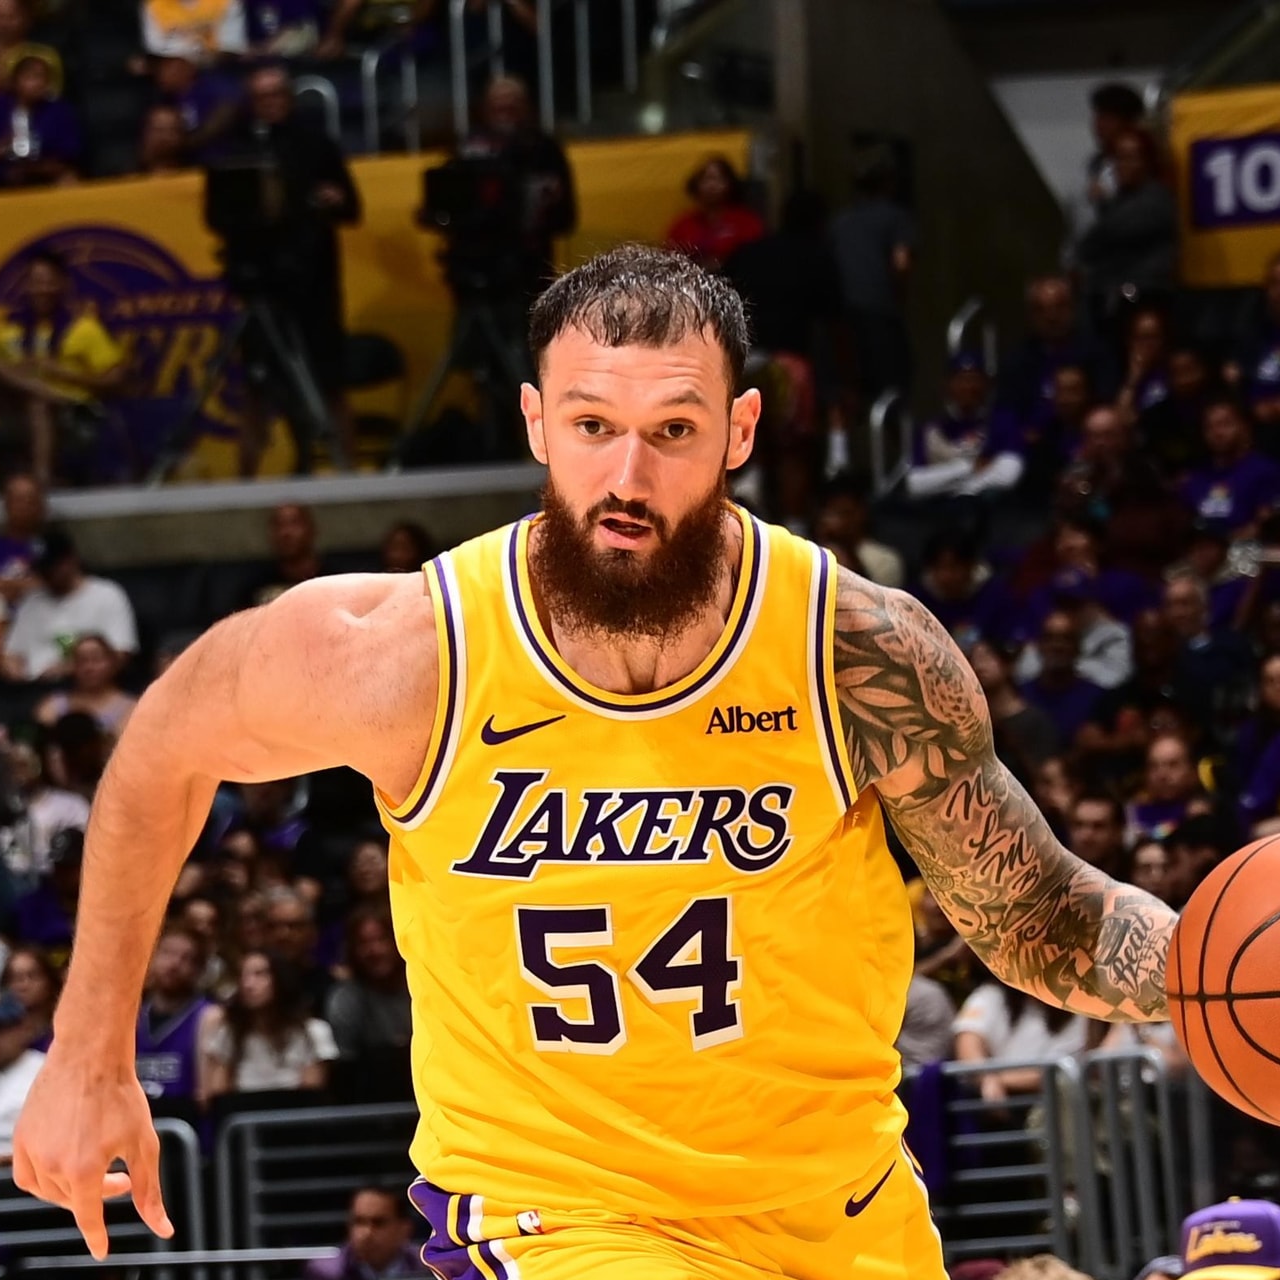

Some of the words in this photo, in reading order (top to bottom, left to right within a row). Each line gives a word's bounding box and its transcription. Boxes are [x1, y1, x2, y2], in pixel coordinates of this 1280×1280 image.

[705, 705, 798, 734] Albert
[448, 768, 797, 882] LAKERS
[513, 895, 744, 1056] 54
